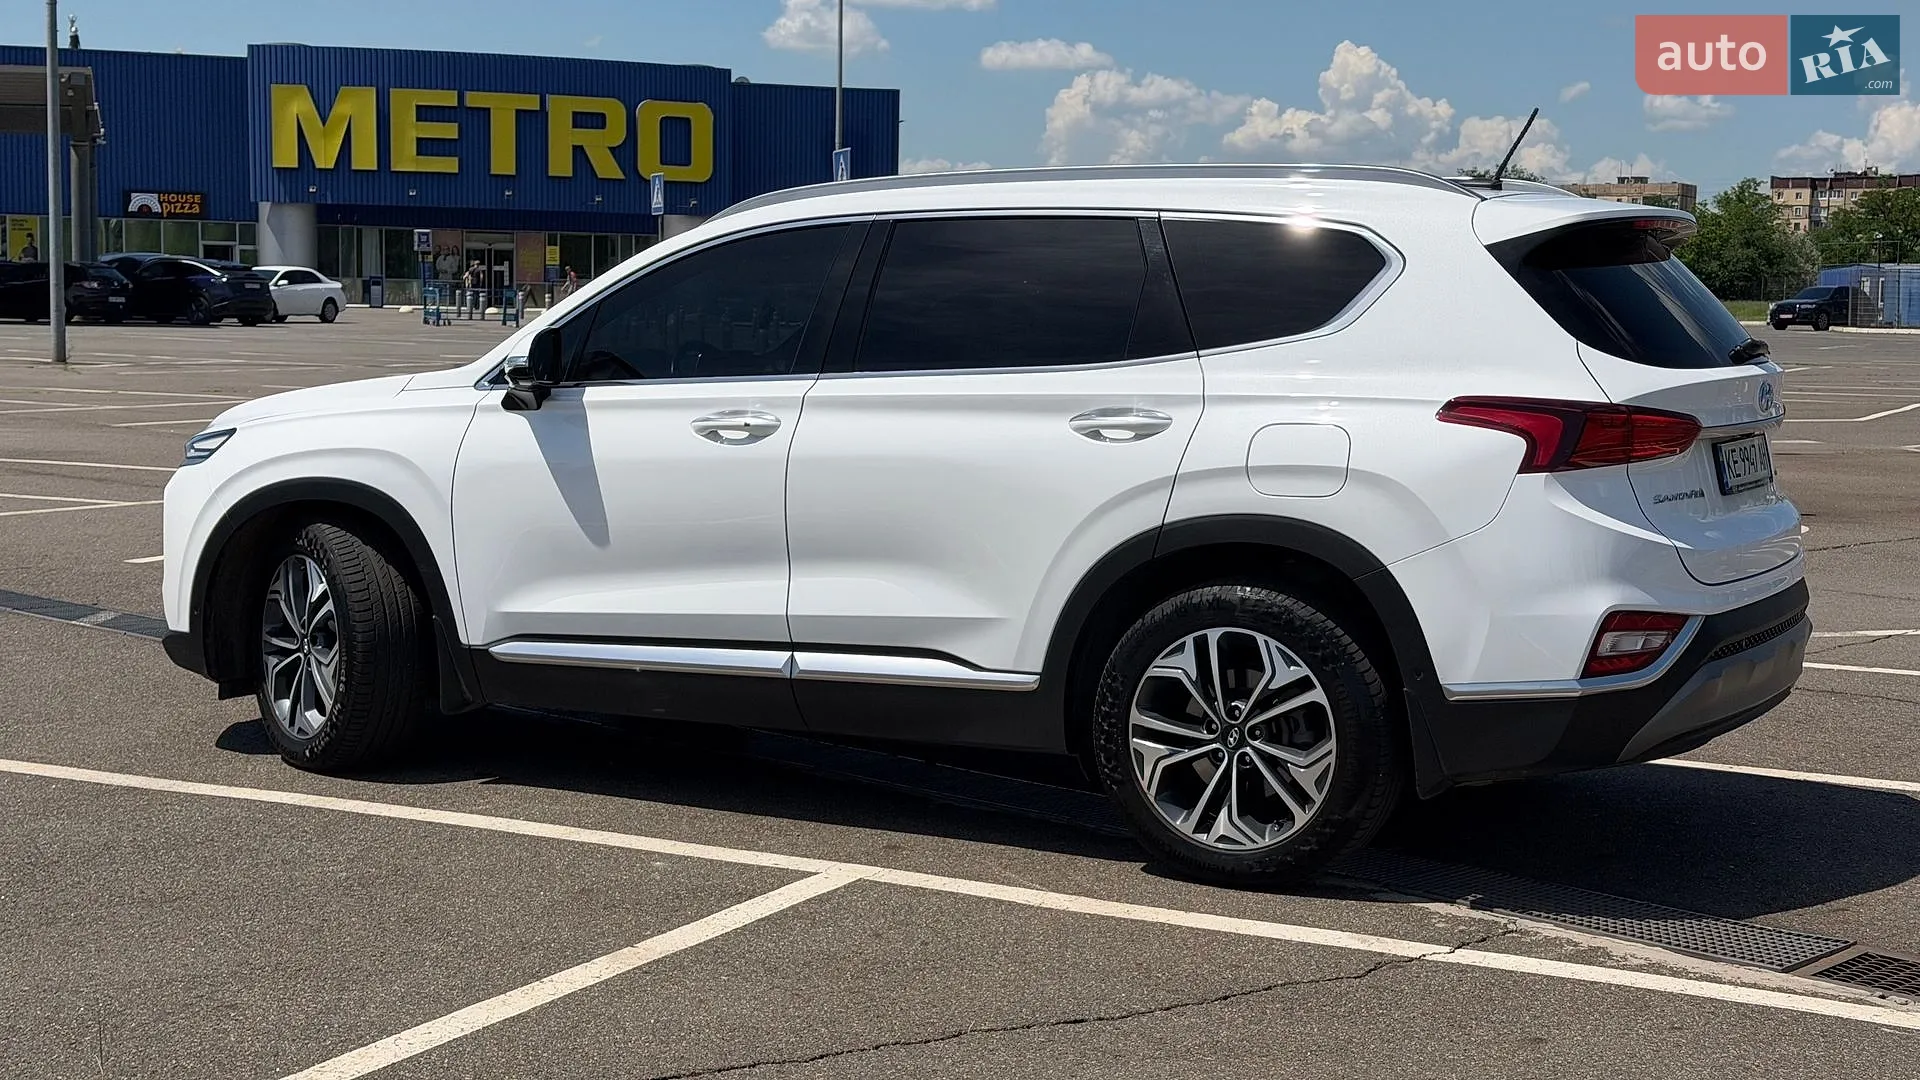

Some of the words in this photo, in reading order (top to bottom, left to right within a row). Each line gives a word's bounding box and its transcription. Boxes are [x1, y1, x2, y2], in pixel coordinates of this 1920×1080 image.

[270, 84, 714, 183] METRO
[160, 194, 201, 202] HOUSE
[1724, 447, 1742, 480] KE
[1739, 444, 1759, 476] 9947
